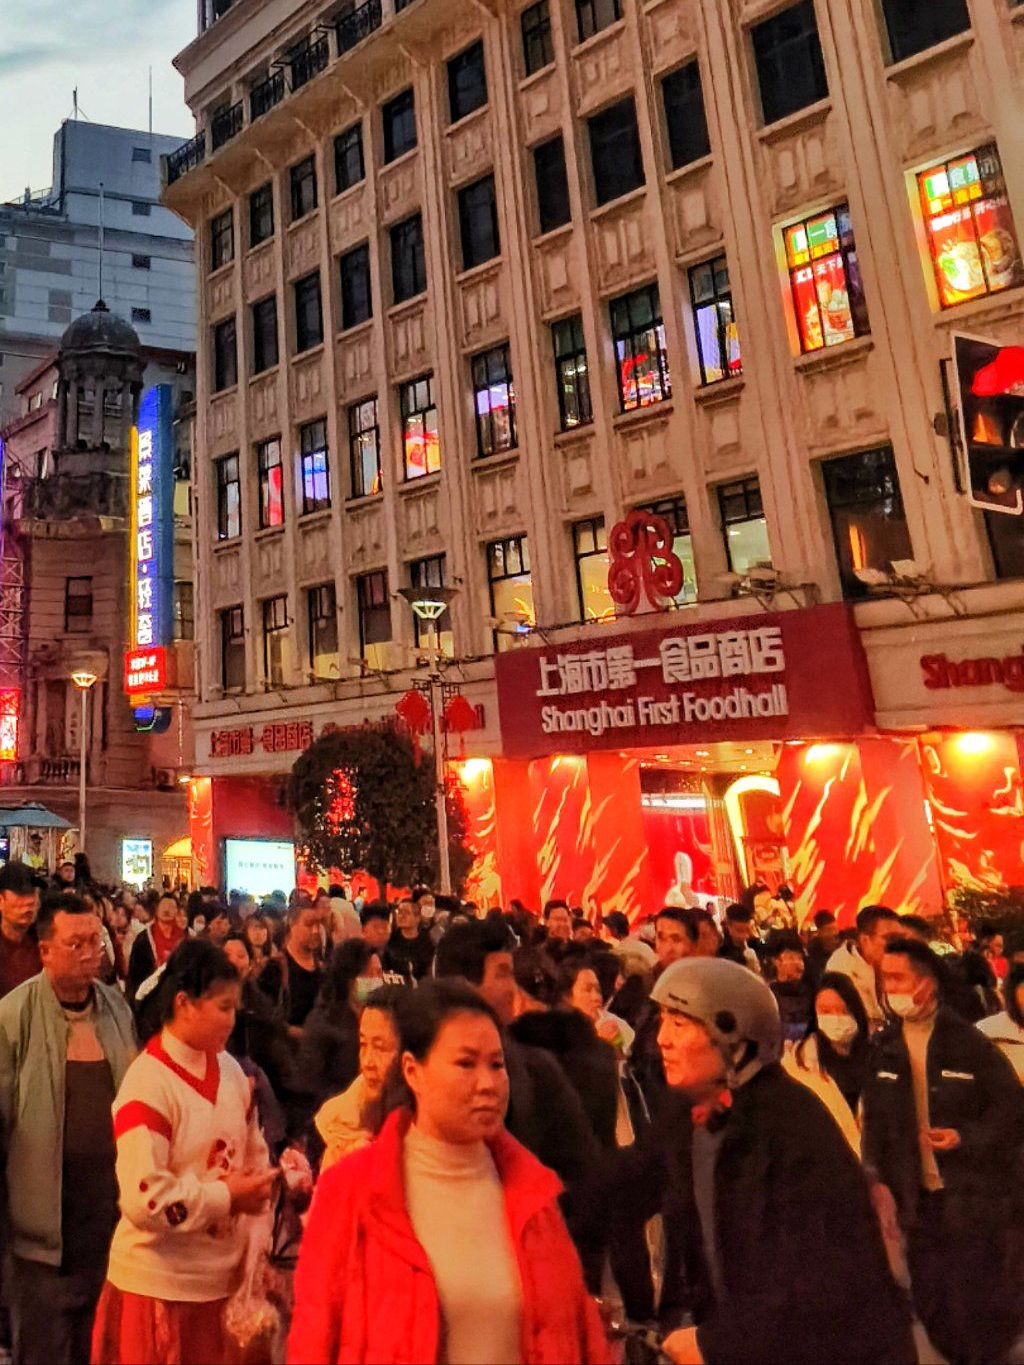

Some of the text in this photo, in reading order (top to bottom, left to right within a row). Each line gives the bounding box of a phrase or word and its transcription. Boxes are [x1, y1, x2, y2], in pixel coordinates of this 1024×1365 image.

[536, 627, 786, 697] 上海市第一食品商店
[541, 684, 789, 735] Shanghai First Foodhall
